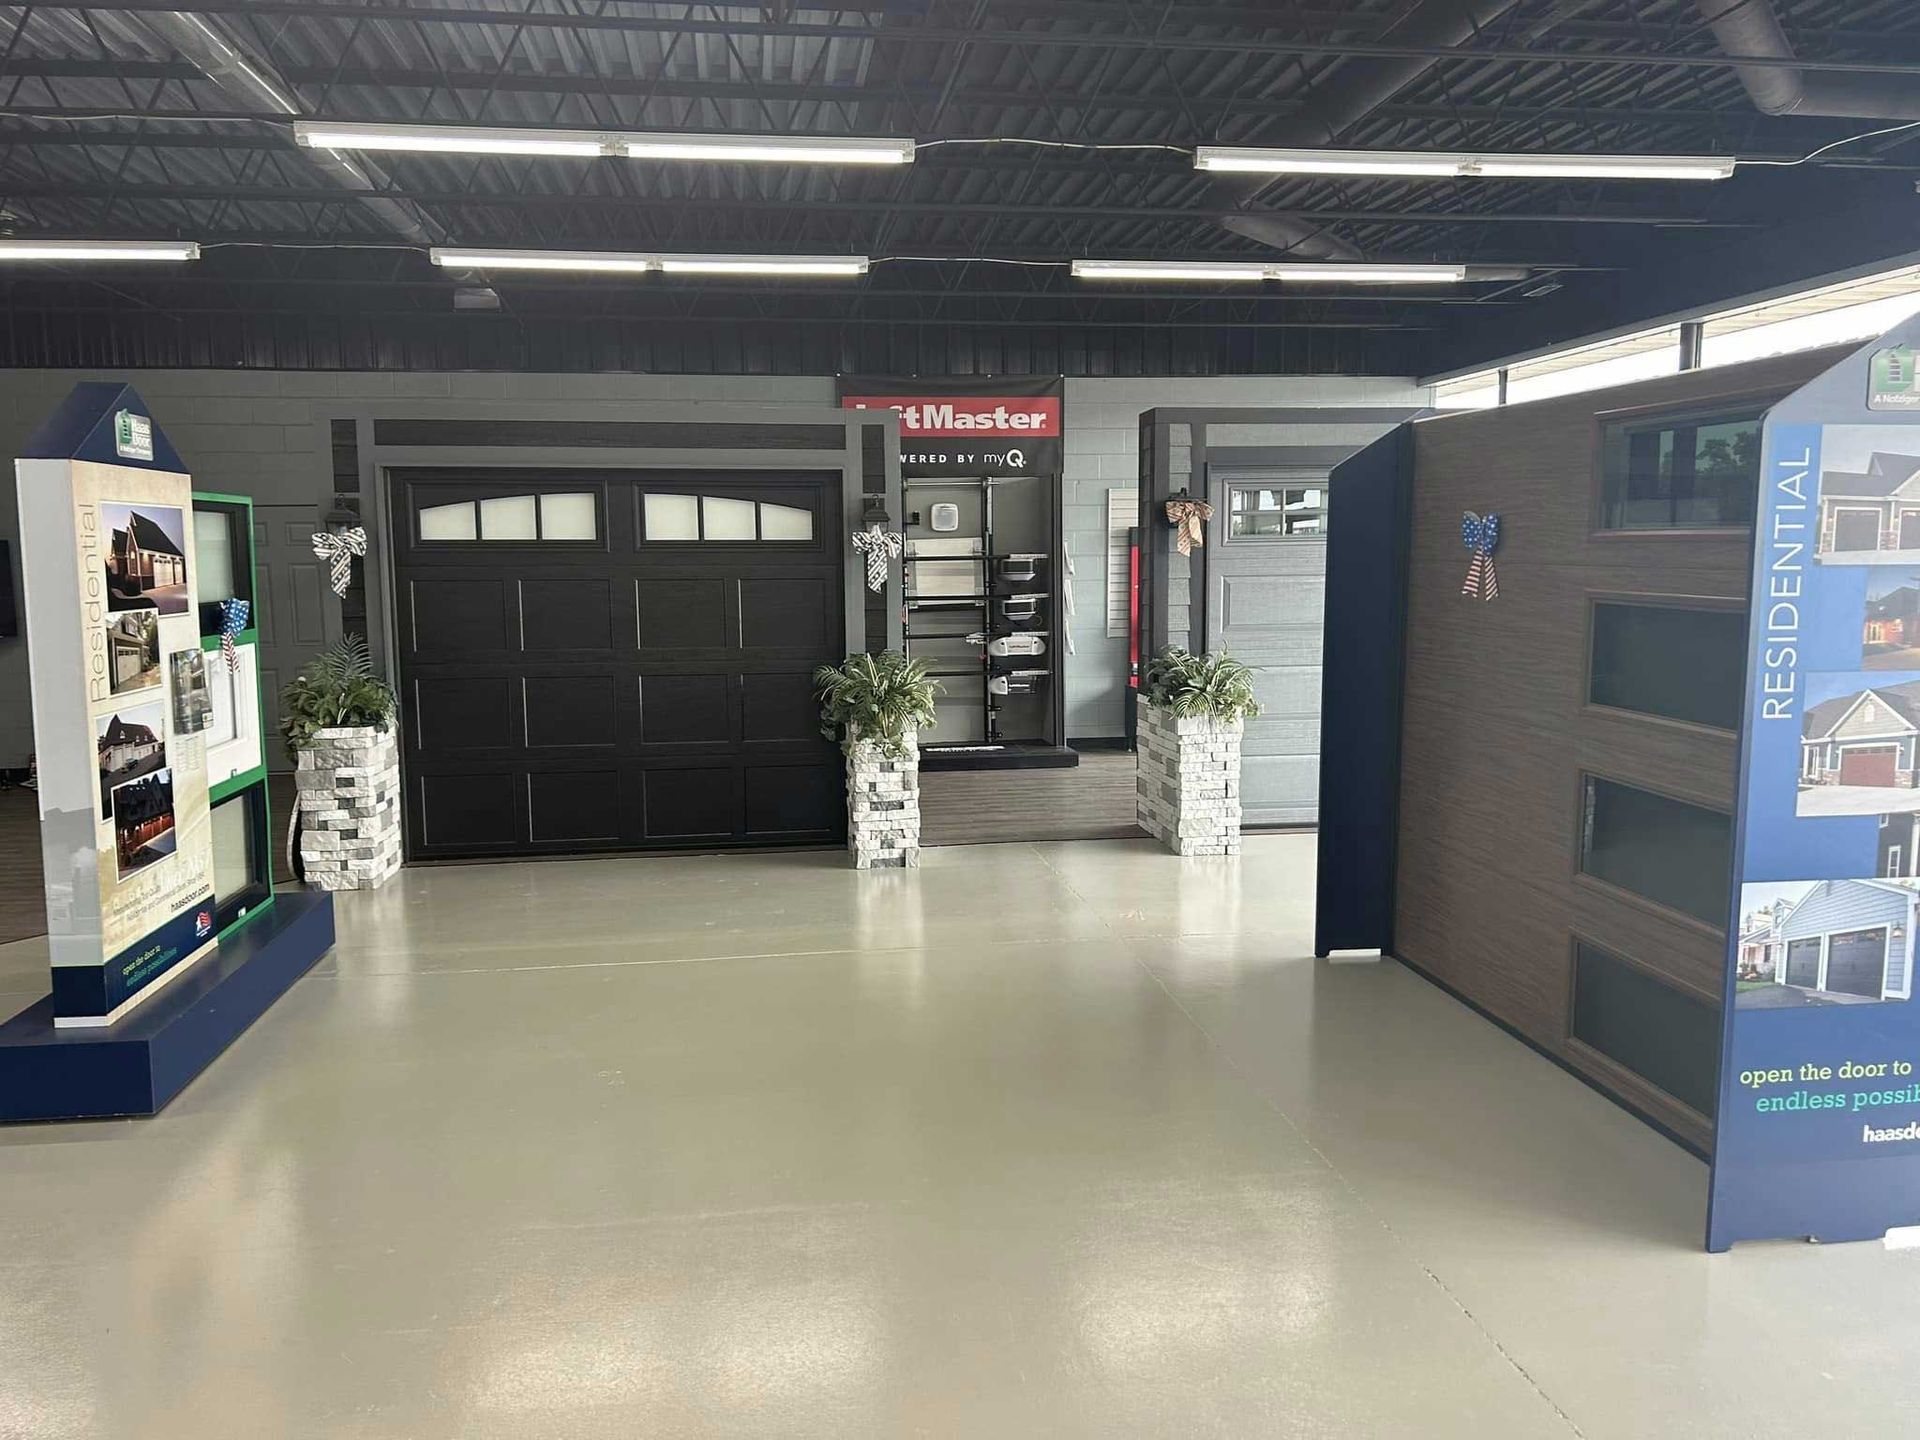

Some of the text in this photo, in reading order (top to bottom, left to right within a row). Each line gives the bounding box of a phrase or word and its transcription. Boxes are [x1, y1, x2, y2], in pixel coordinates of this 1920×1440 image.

[856, 404, 1047, 430] tMaster
[957, 454, 975, 464] BY
[984, 449, 1024, 469] myQ
[1762, 447, 1811, 720] RESIDENTIAL
[78, 503, 107, 703] Residential
[1739, 1060, 1912, 1088] open the door to
[1756, 1091, 1846, 1112] endless
